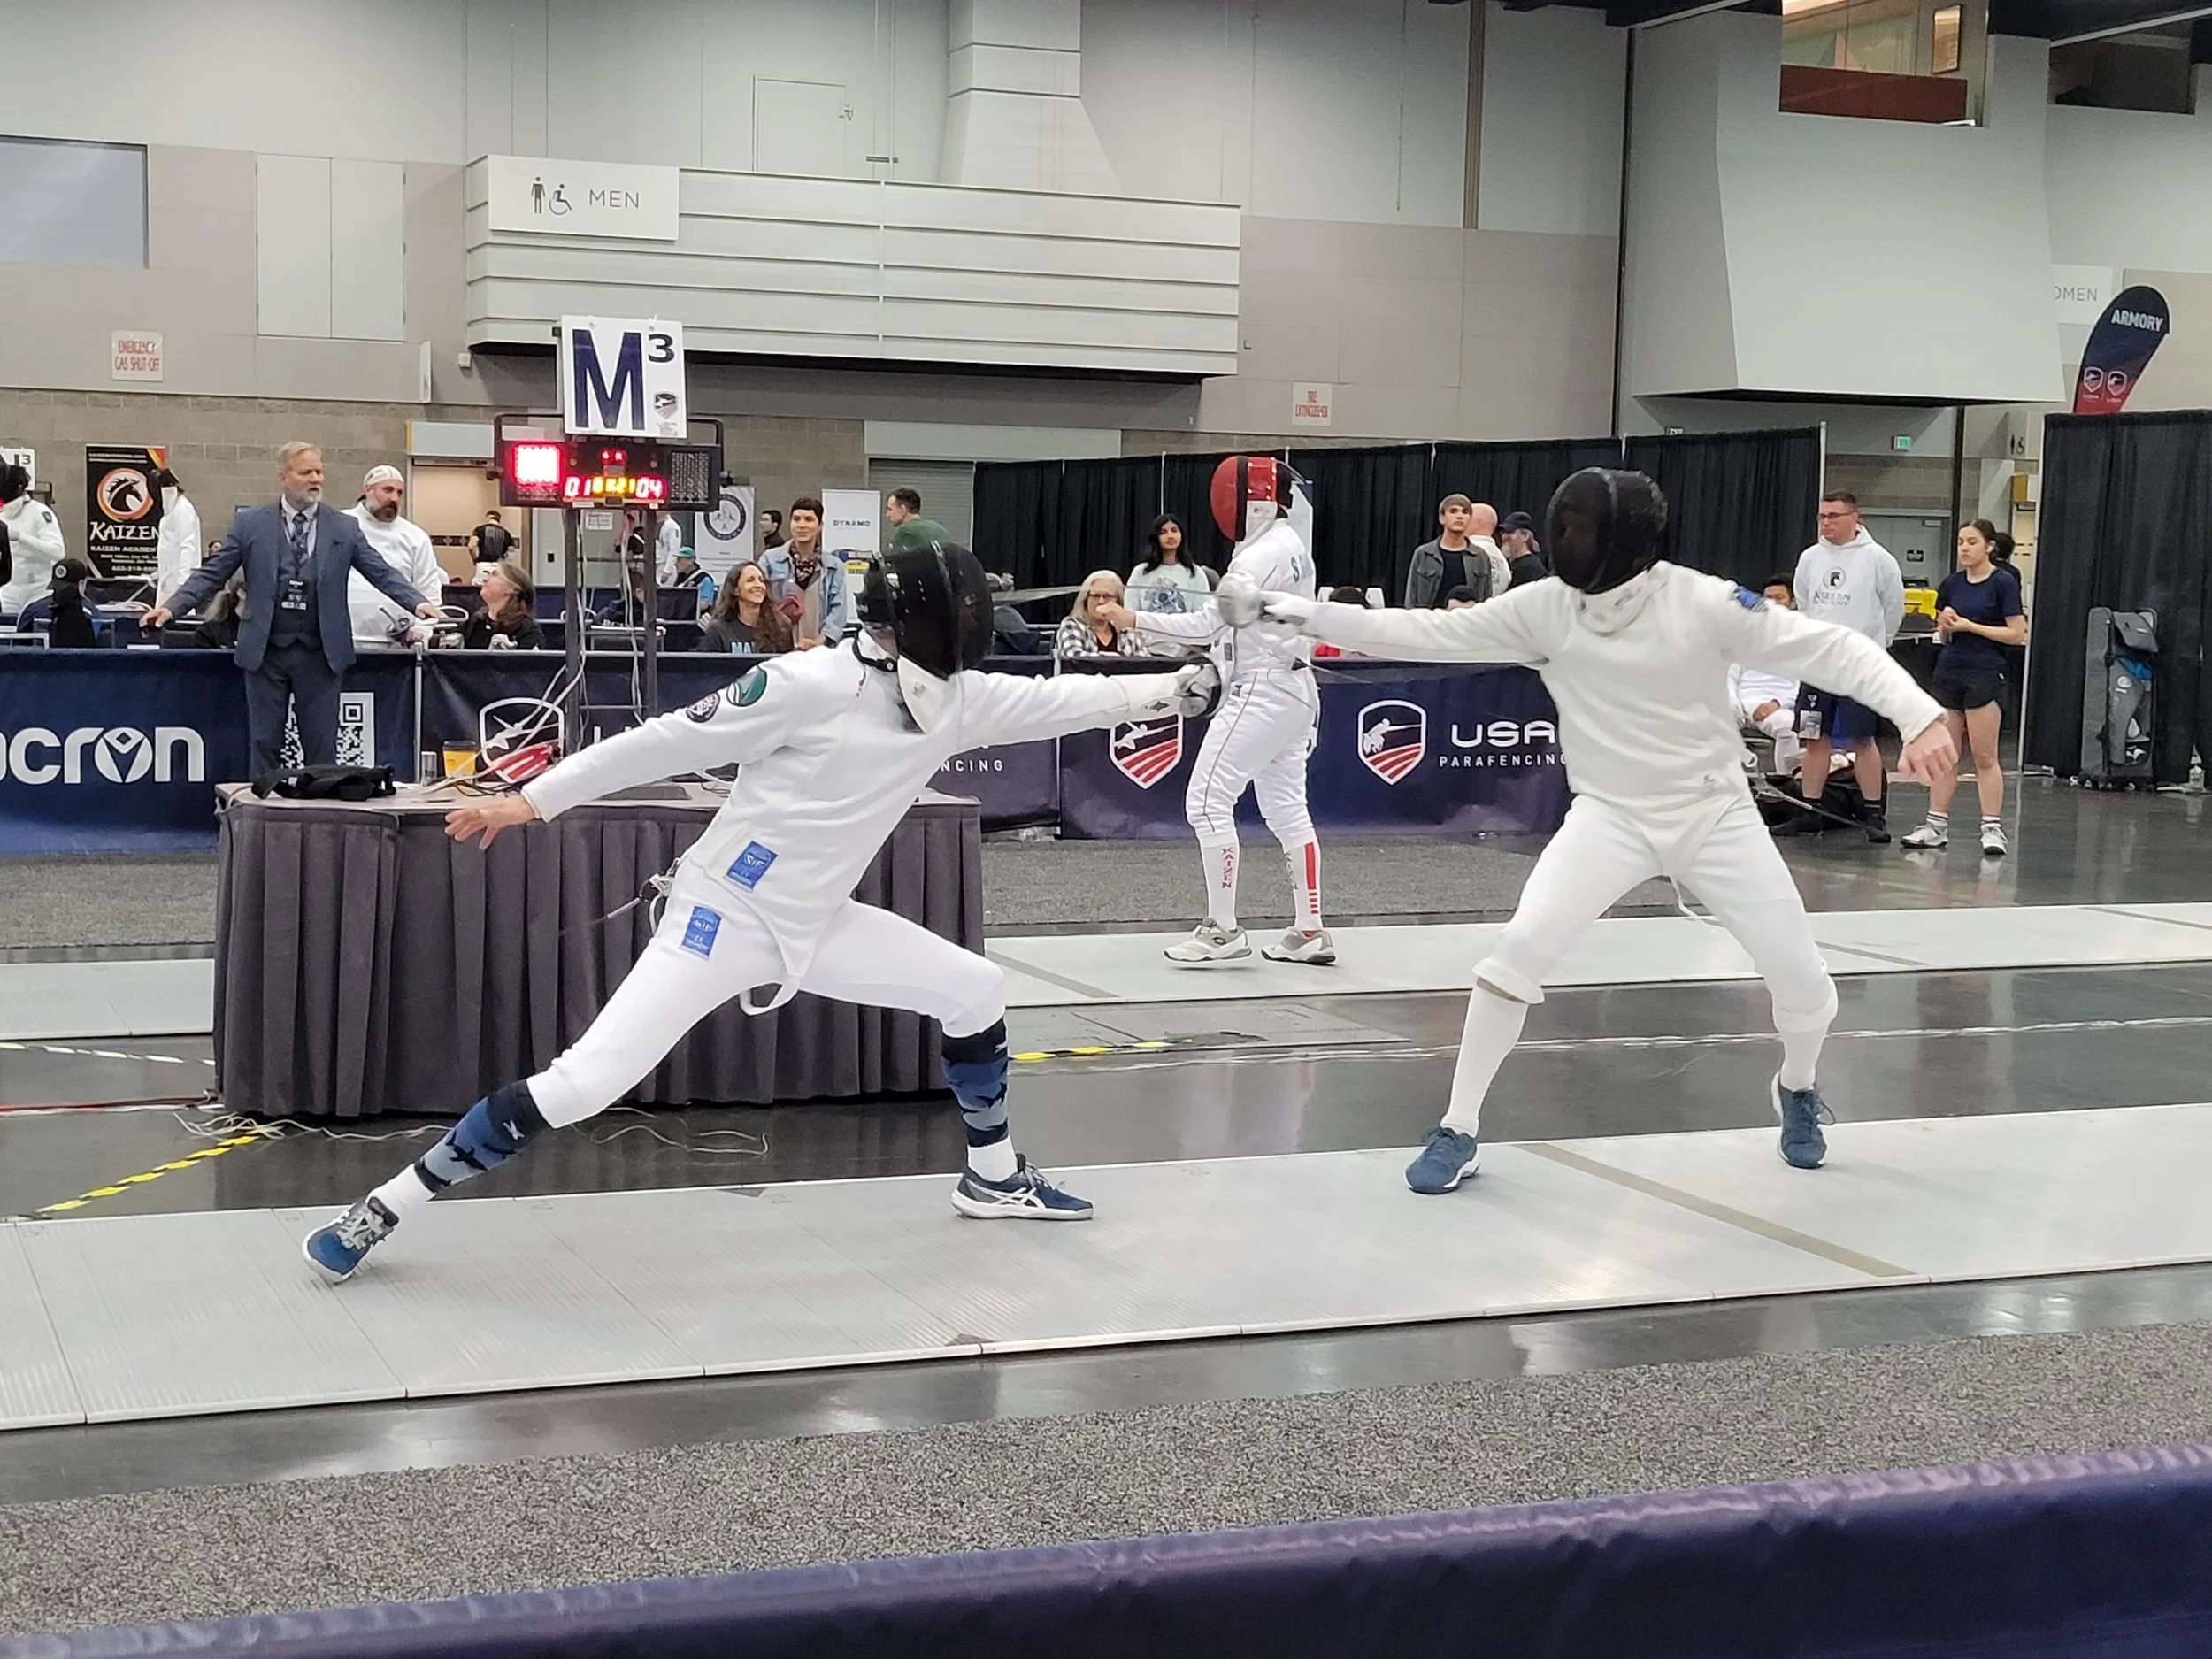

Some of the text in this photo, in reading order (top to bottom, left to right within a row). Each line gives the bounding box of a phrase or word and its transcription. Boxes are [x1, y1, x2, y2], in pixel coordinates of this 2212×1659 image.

[589, 188, 639, 209] MEN
[2111, 309, 2164, 332] ARMORY
[572, 328, 675, 431] M 3
[90, 521, 159, 541] KAIZEN
[1451, 720, 1556, 748] USA
[941, 759, 1004, 772] NCING
